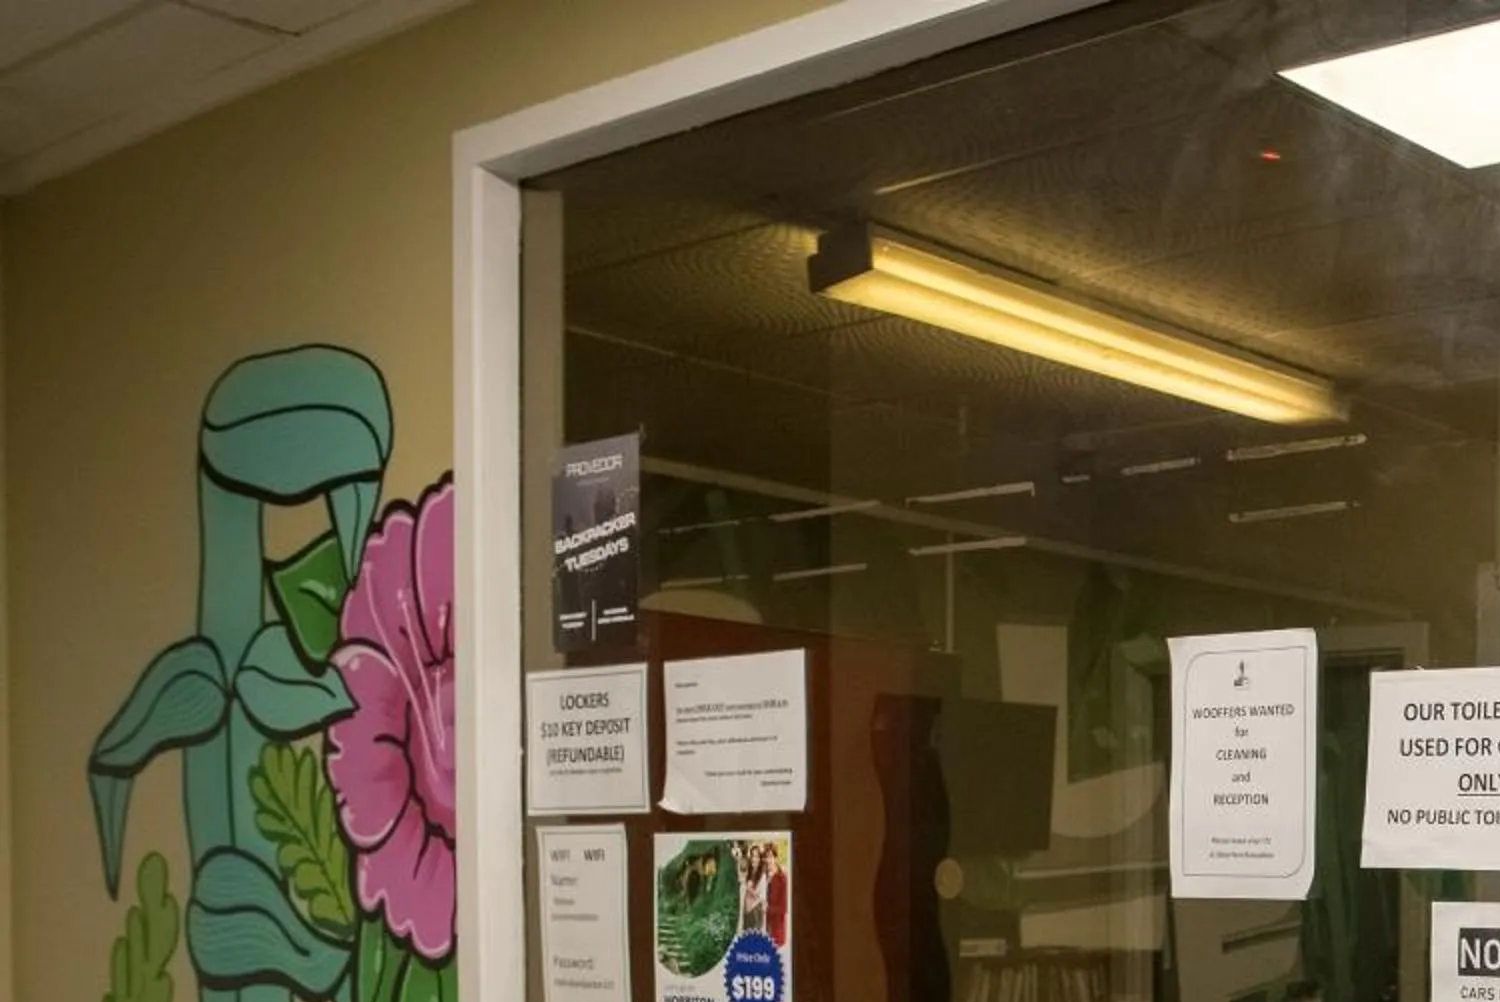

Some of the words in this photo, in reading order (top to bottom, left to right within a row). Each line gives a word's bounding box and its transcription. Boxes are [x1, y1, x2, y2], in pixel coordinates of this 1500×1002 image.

[554, 512, 636, 554] BACKPACKER
[564, 537, 630, 572] TUESDAYS
[560, 692, 609, 710] LOCKERS
[1192, 705, 1247, 719] WOOFFERS
[1250, 703, 1295, 717] WANTED
[1404, 703, 1445, 721] OUR
[541, 722, 559, 739] $10
[562, 721, 582, 736] KEY
[585, 717, 631, 735] DEPOSIT
[1235, 725, 1249, 737] for
[546, 745, 625, 767] (REFUNDABLE)
[1216, 748, 1267, 760] CLEANING
[1400, 738, 1449, 757] USED
[1455, 737, 1493, 756] FOR
[1232, 771, 1251, 783] and
[1213, 793, 1269, 805] RECEPTION
[1387, 809, 1412, 825] NO
[1416, 809, 1470, 825] PUBLIC
[731, 975, 775, 1000] $199
[1461, 985, 1495, 1001] CARS
